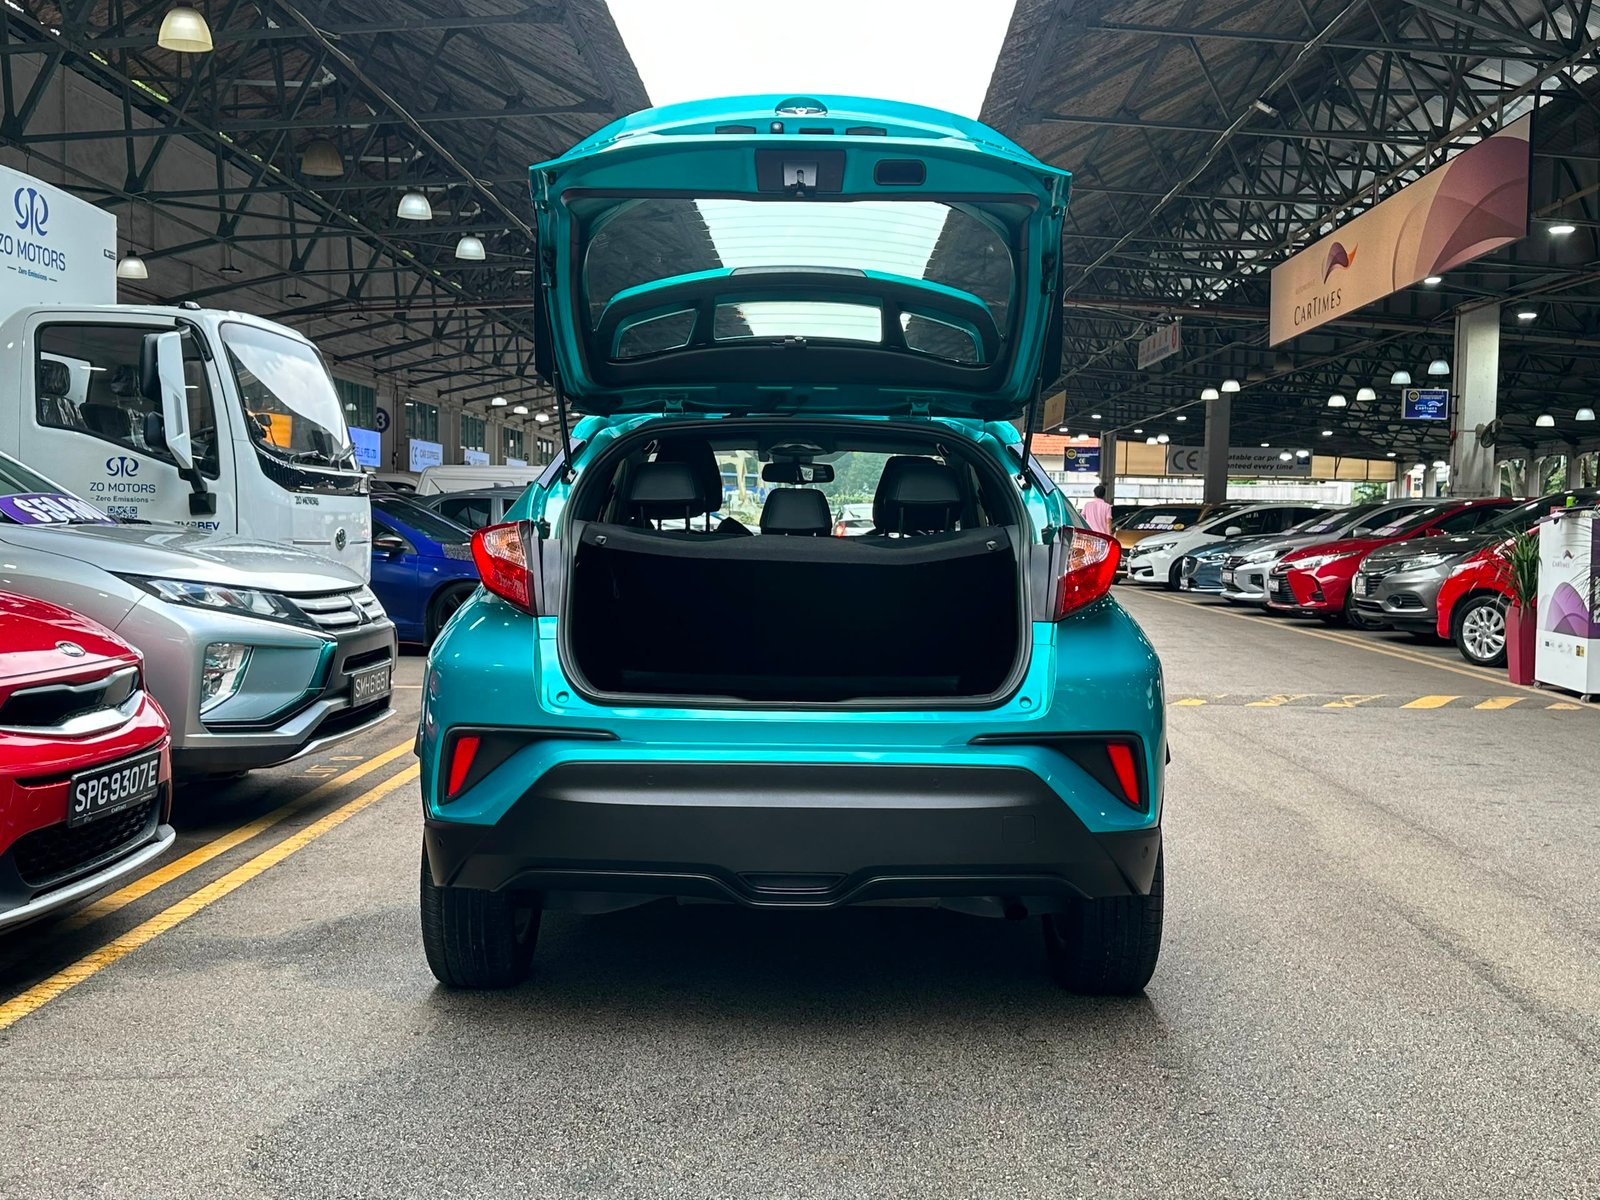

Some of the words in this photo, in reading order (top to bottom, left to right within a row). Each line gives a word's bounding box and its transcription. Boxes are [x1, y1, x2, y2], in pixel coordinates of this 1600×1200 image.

[17, 239, 66, 272] MOTORS
[376, 412, 386, 429] 3
[1254, 463, 1274, 471] every
[89, 482, 105, 492] ZO
[108, 482, 156, 493] MOTORS
[75, 760, 158, 812] SPG9307E
